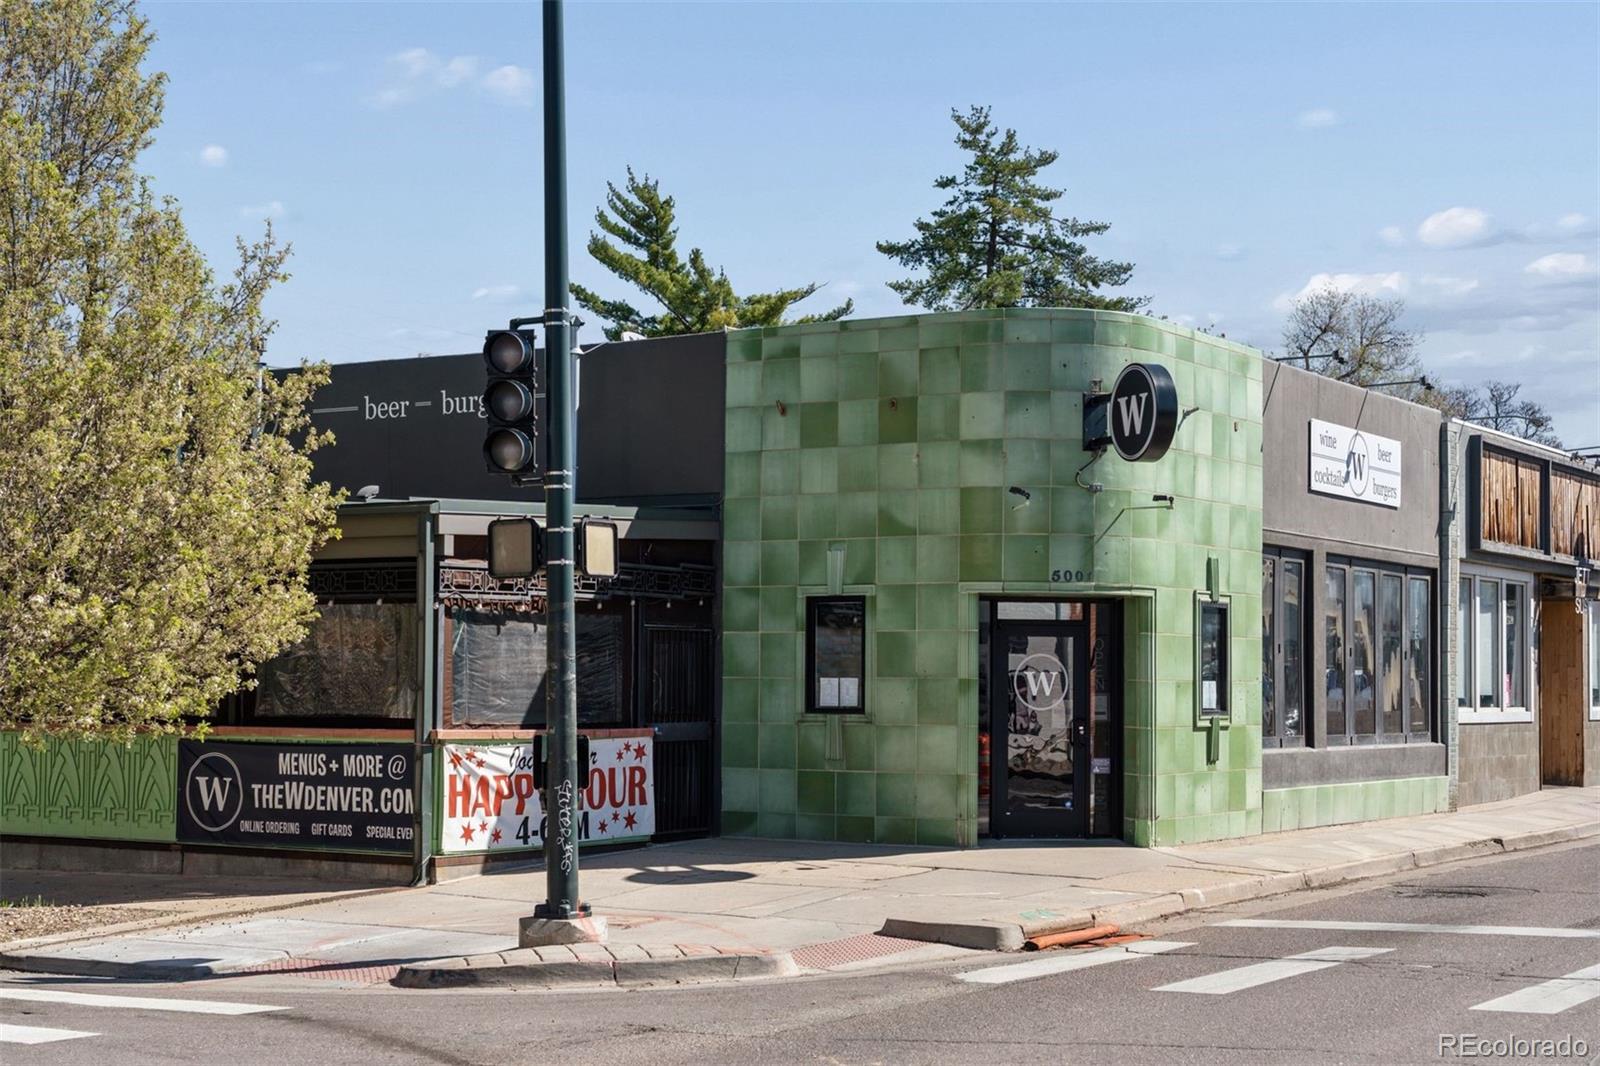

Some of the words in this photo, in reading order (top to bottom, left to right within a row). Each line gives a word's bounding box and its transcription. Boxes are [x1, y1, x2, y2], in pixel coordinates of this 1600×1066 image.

[364, 396, 410, 420] beer
[441, 390, 489, 418] burg
[1117, 392, 1148, 437] W
[1319, 430, 1337, 449] wine
[1350, 451, 1366, 481] W
[1377, 443, 1392, 463] beer
[1314, 467, 1345, 488] cocktails
[1373, 478, 1398, 502] burgers
[1023, 671, 1059, 697] W
[278, 753, 327, 776] MENUS
[329, 760, 339, 772] +
[343, 754, 384, 778] MORE
[388, 754, 407, 780] @
[195, 776, 233, 812] W
[448, 773, 535, 818] HAPP
[240, 820, 264, 833] ONLINE
[265, 821, 300, 835] ORDERING
[311, 823, 328, 836] GIFT
[328, 824, 353, 837] CARDS
[366, 825, 395, 839] SPECIAL
